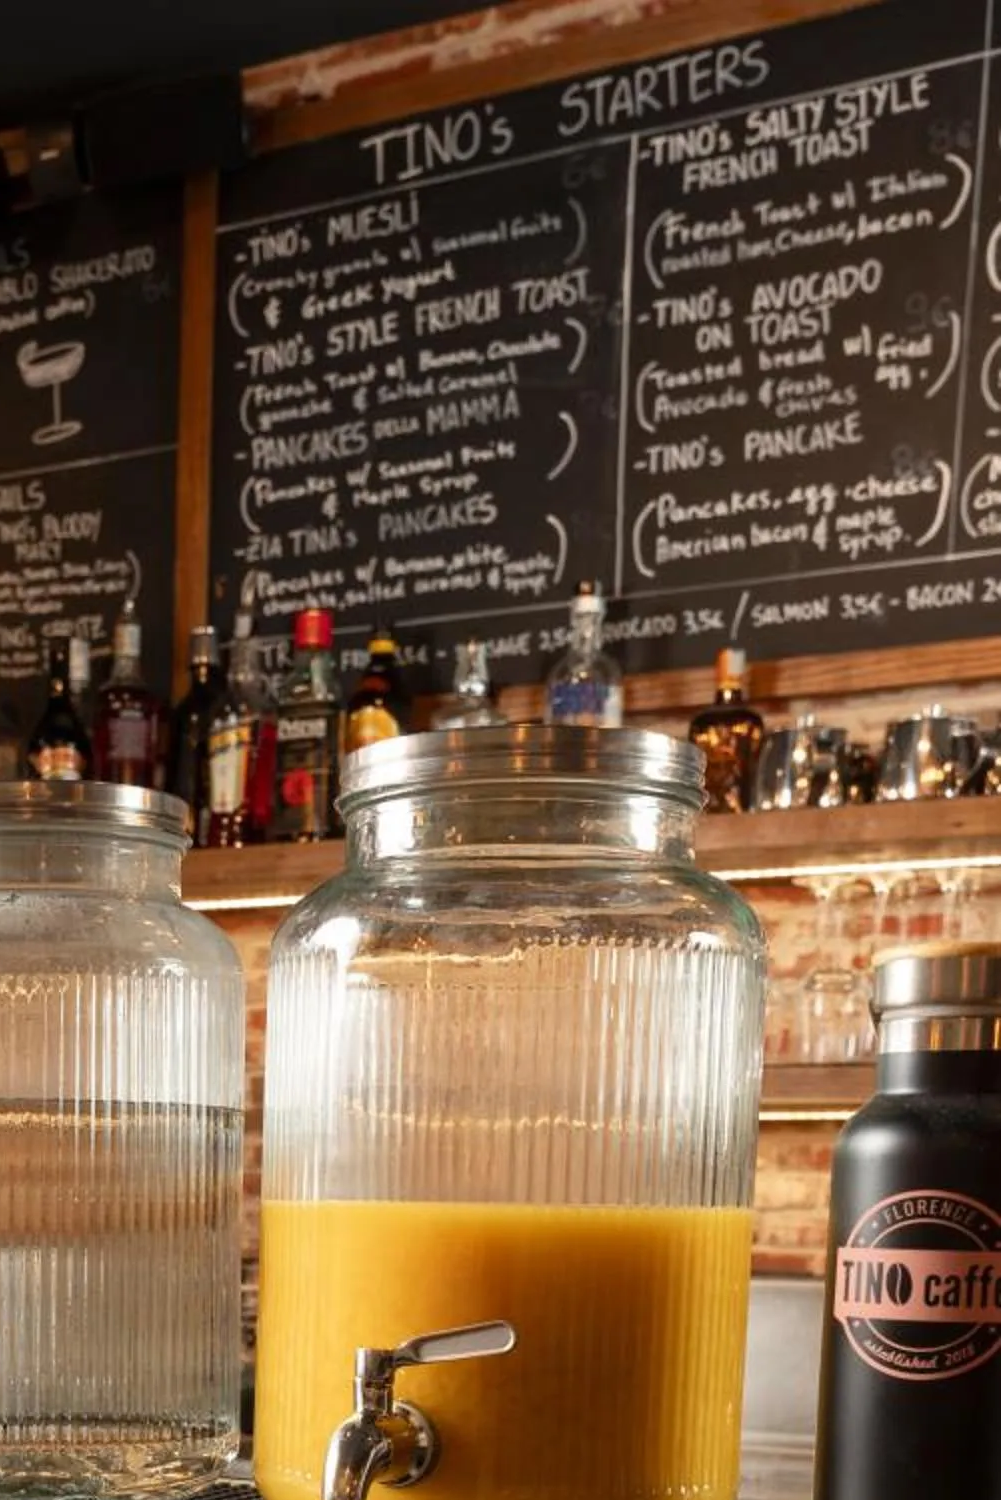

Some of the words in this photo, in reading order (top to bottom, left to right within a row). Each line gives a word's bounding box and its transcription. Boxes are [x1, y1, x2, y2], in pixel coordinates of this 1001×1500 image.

[359, 103, 514, 185] TINO's
[557, 39, 769, 138] STARTERS
[744, 97, 825, 147] SALTY
[833, 71, 931, 127] STYLE
[682, 146, 778, 194] FRENCH
[787, 118, 876, 168] TOAST
[751, 258, 883, 312] AVOCADO
[326, 310, 400, 358] STYLE
[413, 285, 502, 337] FRENCH
[510, 266, 591, 314] TOAST
[694, 322, 733, 353] ON
[743, 300, 837, 345] TOAST
[426, 387, 520, 437] MAMMA
[744, 411, 865, 462] PANCAKE
[377, 490, 501, 542] PANCAKES
[750, 596, 830, 628] SALMON
[906, 580, 974, 612] BACON
[881, 1198, 979, 1226] FLORENCE
